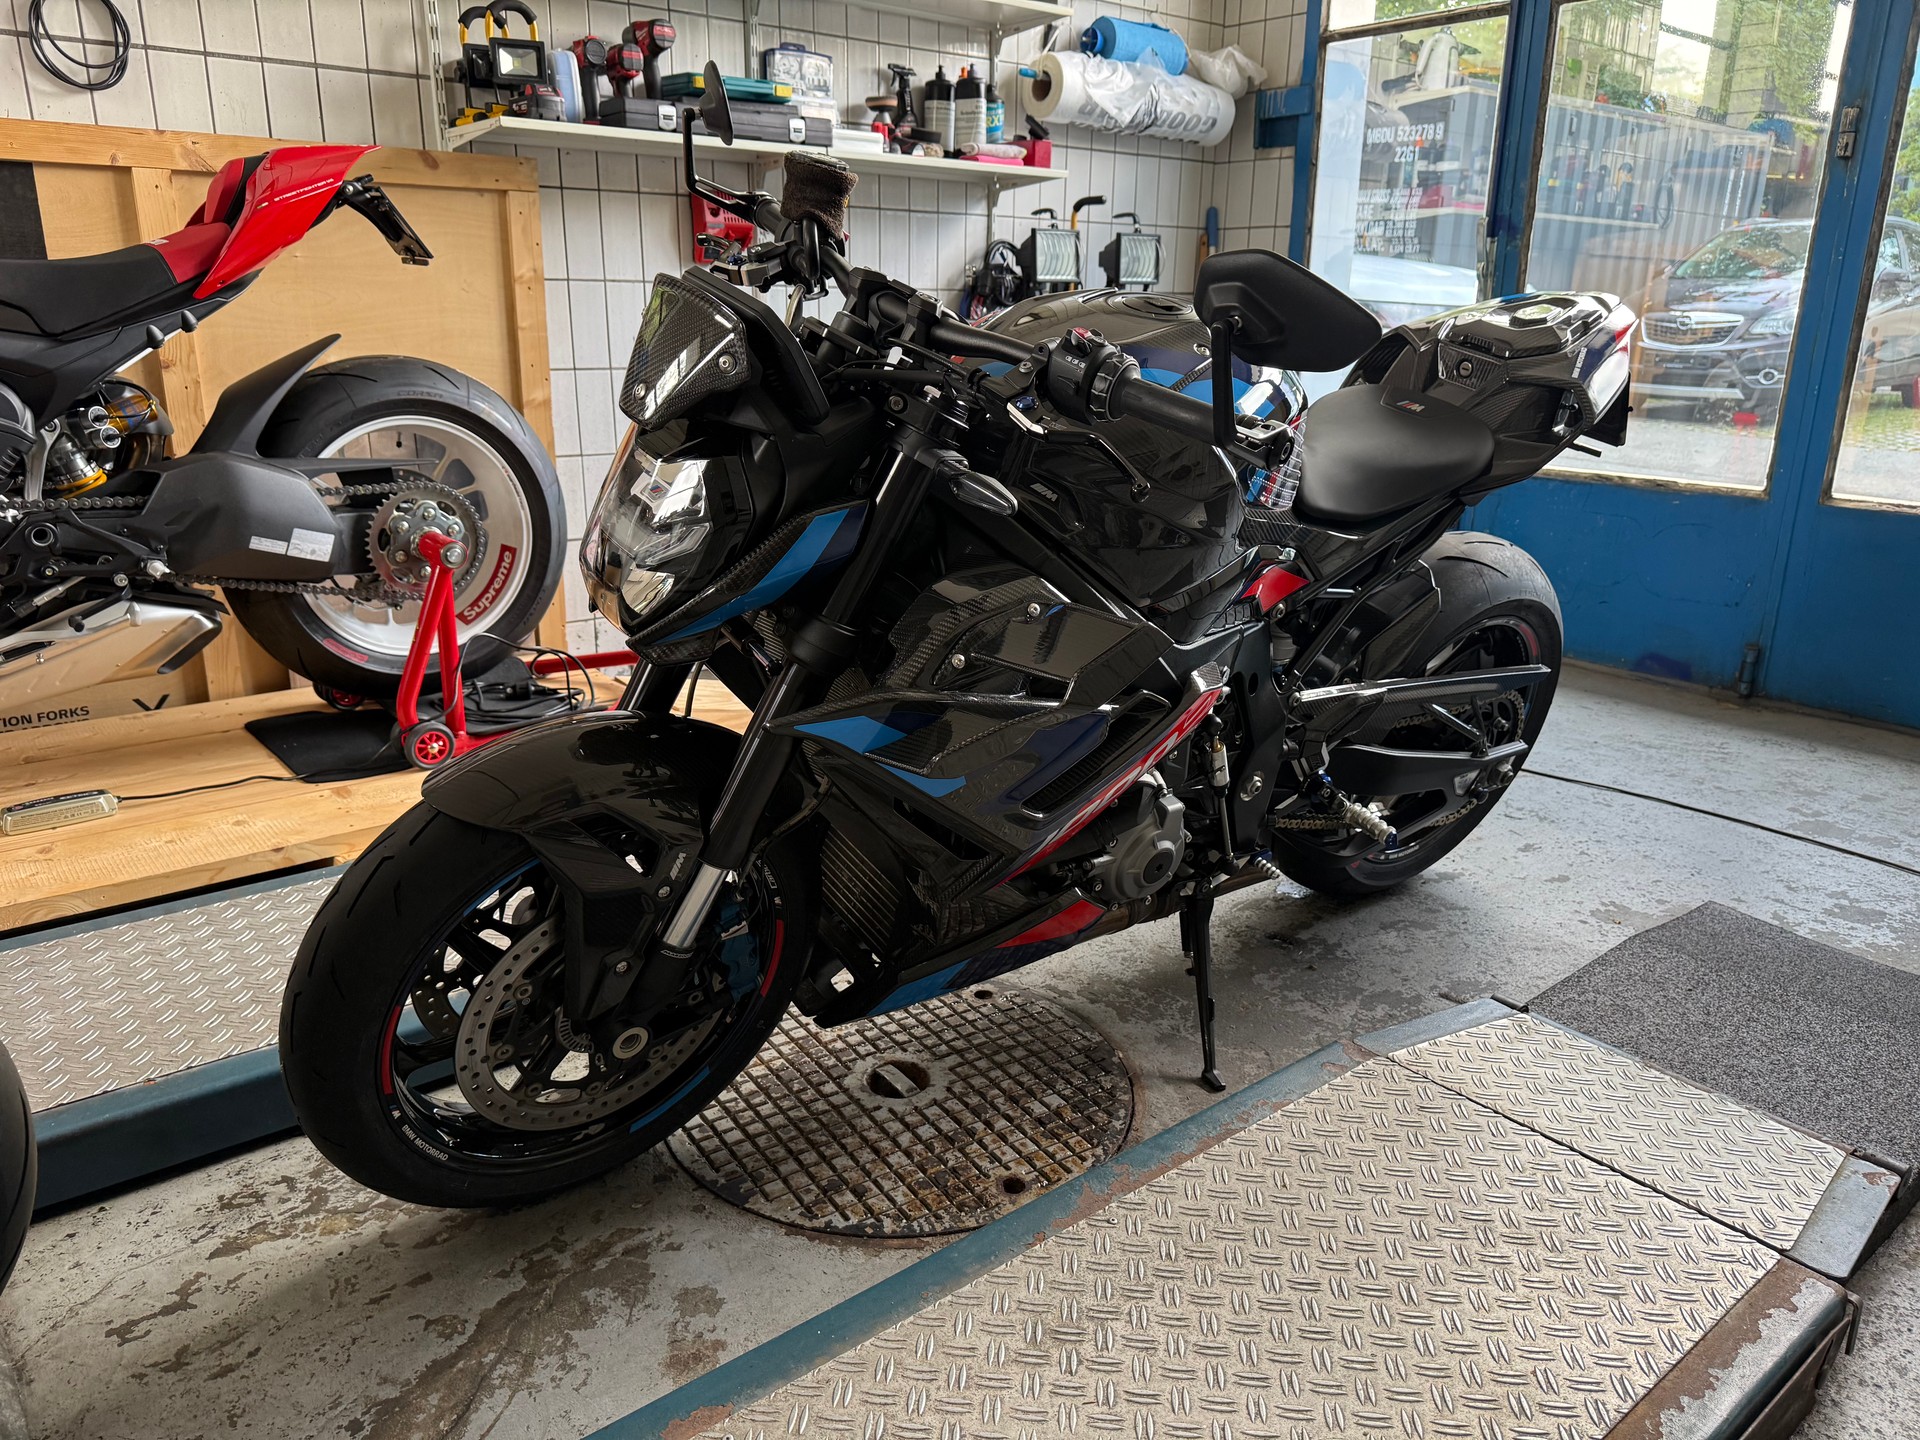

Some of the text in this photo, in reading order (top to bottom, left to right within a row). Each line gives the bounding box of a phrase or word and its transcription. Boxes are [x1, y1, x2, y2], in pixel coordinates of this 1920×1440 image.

[1396, 123, 1435, 142] 523278
[1393, 145, 1420, 163] 22G1
[463, 550, 513, 621] Supreme
[0, 713, 33, 728] ION
[37, 705, 90, 723] FORKS
[401, 1124, 449, 1161] BMW MOTORRAD
